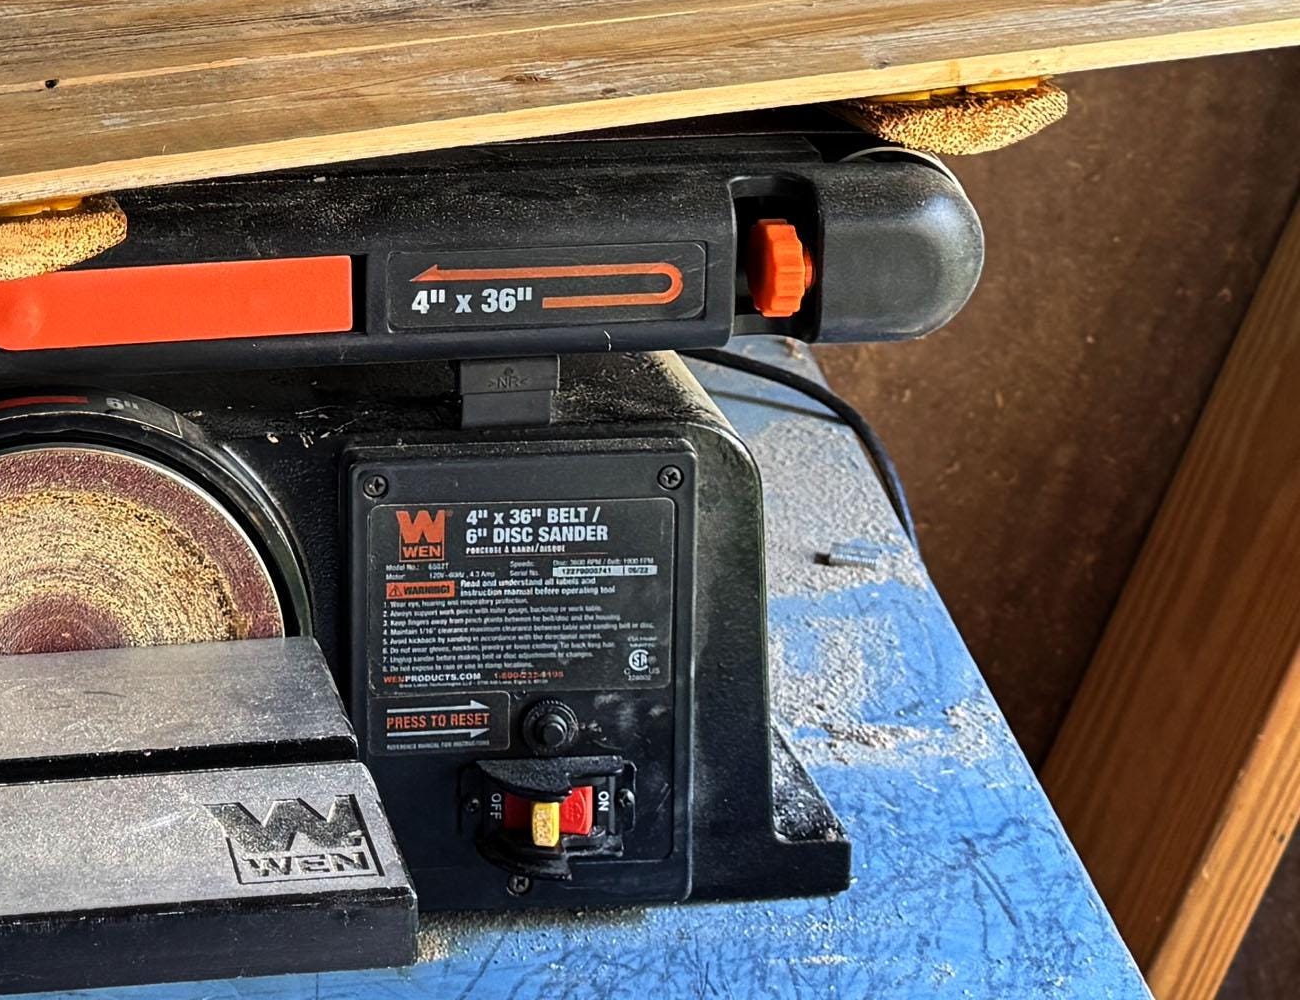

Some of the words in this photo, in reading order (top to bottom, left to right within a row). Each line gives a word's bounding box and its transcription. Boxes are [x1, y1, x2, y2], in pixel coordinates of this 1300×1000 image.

[412, 289, 445, 314] 4"
[455, 295, 472, 313] x
[481, 287, 532, 313] 36"
[466, 509, 488, 525] 4"
[494, 513, 504, 524] x
[509, 508, 542, 524] 36"
[547, 507, 588, 523] BELT
[592, 506, 600, 523] /
[466, 528, 487, 544] 6"
[493, 527, 533, 544] DISC
[538, 525, 608, 543] SANDER
[403, 545, 441, 558] WEN
[404, 585, 450, 595] WARNING!
[460, 580, 480, 588] Read
[499, 578, 543, 586] understand
[461, 589, 502, 597] instruction
[504, 588, 533, 596] manual
[535, 587, 559, 595] before
[562, 586, 599, 595] operating
[383, 673, 481, 682] WENPRODUCTS.COM
[387, 715, 426, 729] PRESS
[431, 714, 446, 727] TO
[451, 713, 490, 726] RESET
[490, 793, 502, 820] OFF
[598, 791, 610, 811] ON
[242, 851, 370, 877] WEN
